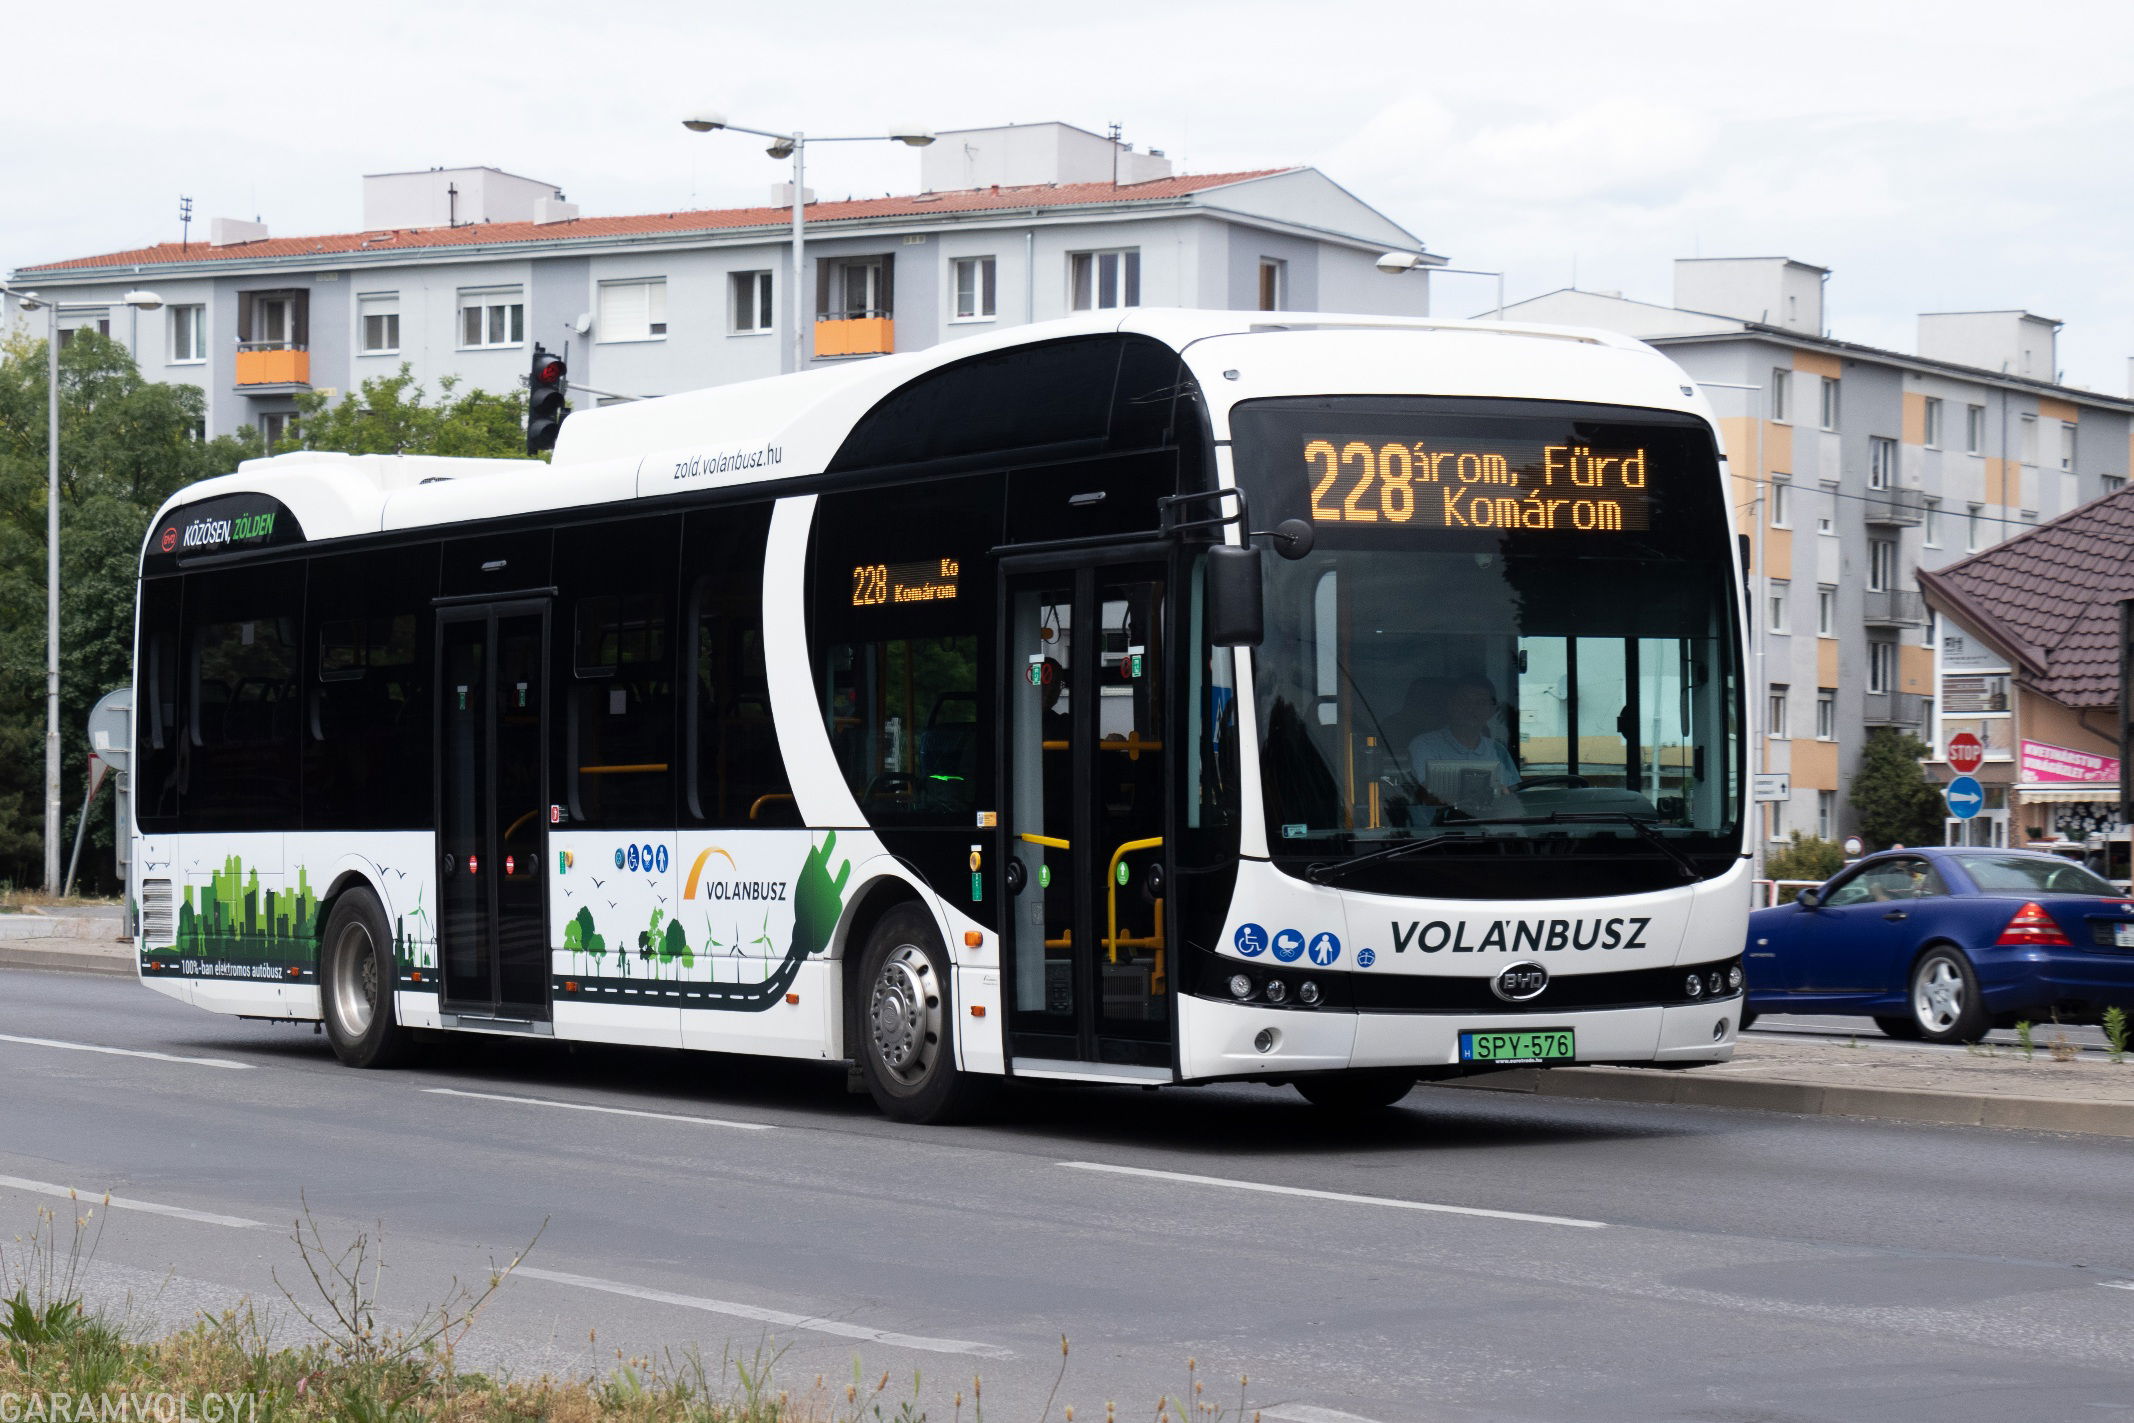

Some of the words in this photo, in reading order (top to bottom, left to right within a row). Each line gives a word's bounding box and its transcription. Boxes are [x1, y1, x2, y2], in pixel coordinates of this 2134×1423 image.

[674, 442, 782, 479] zold.volanbusz.hu
[1545, 446, 1645, 488] Fürd
[1305, 440, 1414, 522] 228
[1443, 487, 1622, 530] Komárom
[183, 519, 232, 547] KÖZÖSEN,
[233, 512, 275, 540] ZÖLDEN
[941, 558, 959, 577] Ko
[853, 564, 887, 606] 228
[894, 582, 957, 602] Komárom
[1950, 744, 1980, 761] STOP
[706, 881, 786, 901] VOLÁNBUSZ
[1391, 918, 1652, 953] VOLÁNBUSZ
[181, 959, 214, 975] 100%-ban
[214, 961, 250, 977] elektromos
[252, 962, 283, 979] autóbusz
[1503, 972, 1543, 989] BYD
[1464, 1050, 1471, 1058] H
[1478, 1034, 1569, 1058] SPY-576
